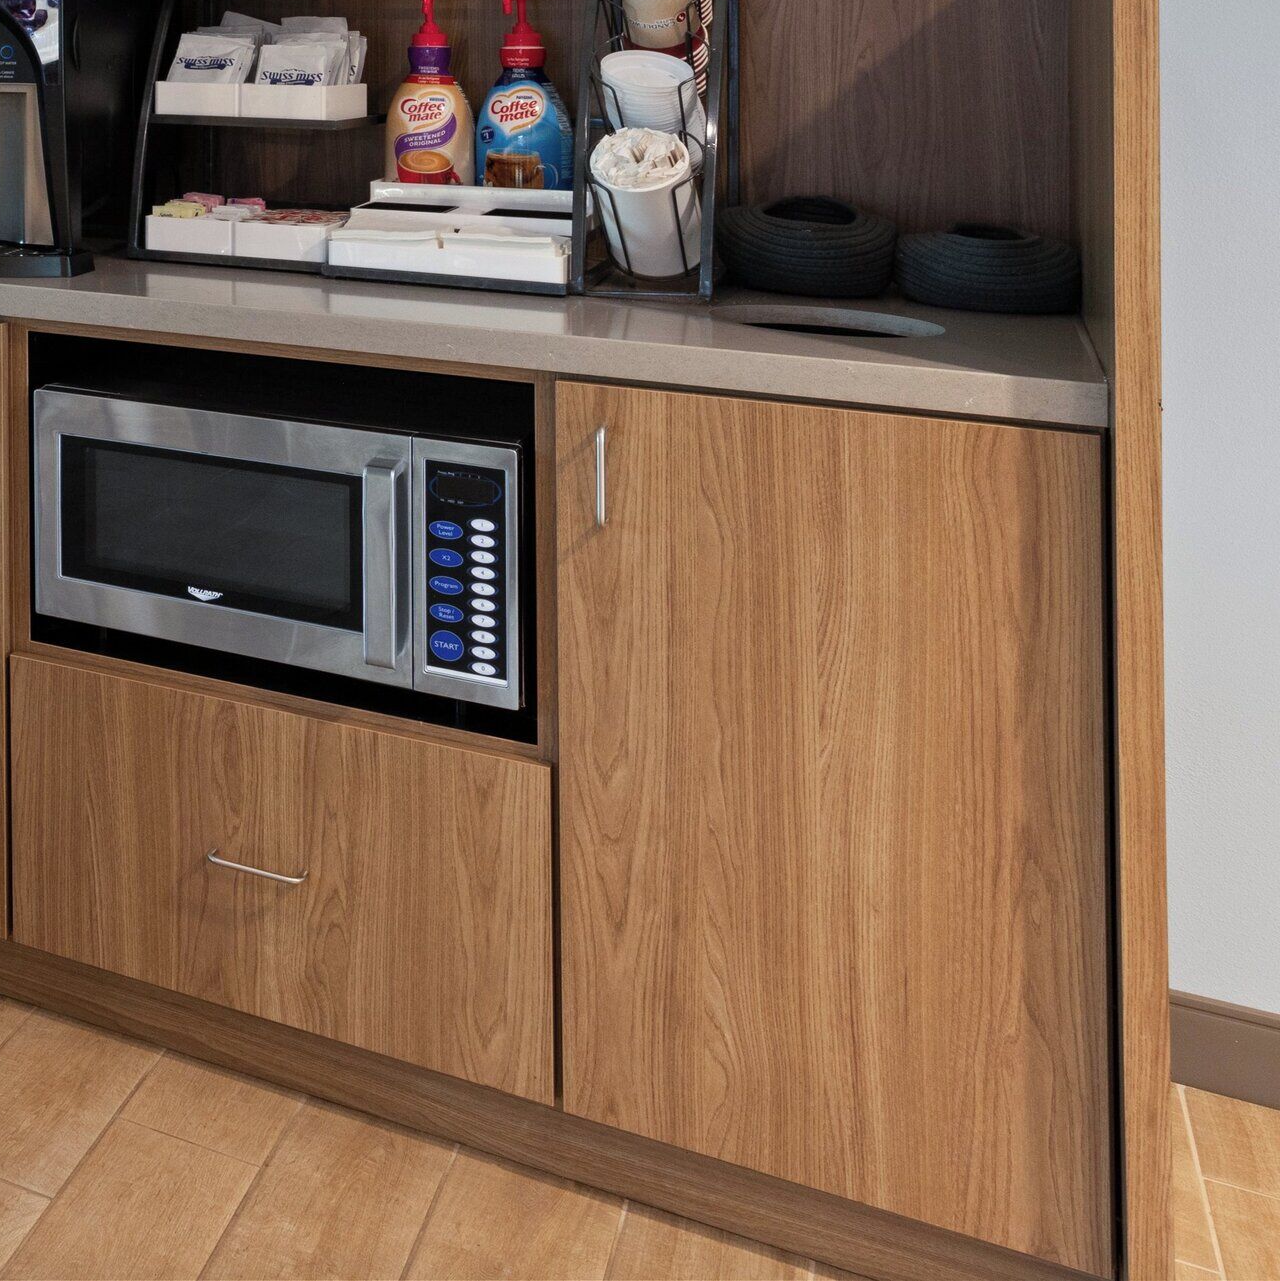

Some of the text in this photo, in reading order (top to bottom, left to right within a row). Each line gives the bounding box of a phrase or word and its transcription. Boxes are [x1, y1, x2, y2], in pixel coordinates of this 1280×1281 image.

[260, 70, 294, 80] Swiss
[401, 98, 445, 115] Coffee
[491, 100, 538, 115] Coffee
[409, 112, 442, 122] mate
[500, 109, 538, 122] mate
[404, 130, 446, 143] SWEETENED
[409, 138, 441, 147] ORIGINAL
[436, 523, 455, 531] Power
[434, 580, 459, 589] Program
[438, 606, 451, 614] Stop
[438, 612, 455, 620] Reset
[434, 640, 459, 651] START
